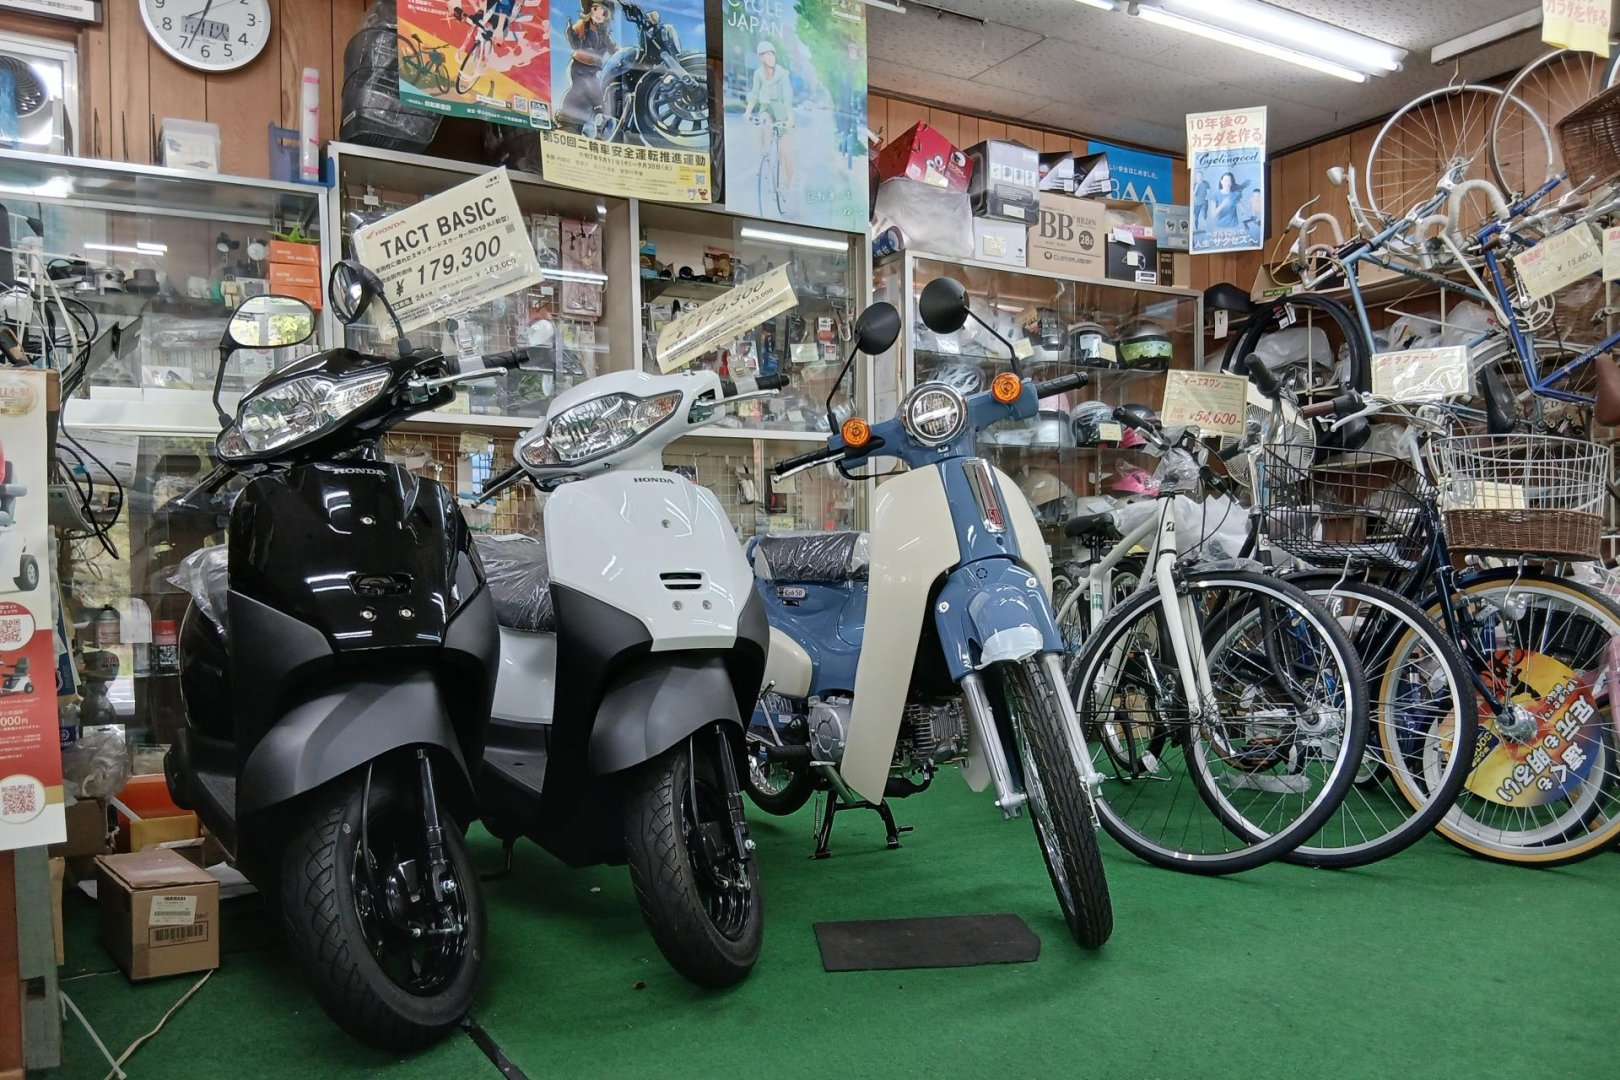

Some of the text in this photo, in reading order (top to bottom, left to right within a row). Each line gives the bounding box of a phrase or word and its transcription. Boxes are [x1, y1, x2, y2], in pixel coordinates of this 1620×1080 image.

[162, 17, 172, 31] 8
[247, 13, 256, 27] 3
[728, 12, 783, 38] JAPAN
[179, 35, 188, 49] 7
[238, 33, 248, 46] 4
[200, 45, 211, 58] 6
[224, 43, 233, 57] 5
[1190, 115, 1247, 130] 10年後の
[1192, 127, 1262, 147] カラダを作る
[543, 131, 706, 166] 第50回二輪車安全運転推進運動
[1199, 152, 1258, 168] Cyclingood
[375, 219, 406, 236] HONDA
[380, 197, 497, 259] TACT BASIC
[1039, 210, 1074, 241] BB
[417, 235, 501, 286] 179,300
[333, 467, 387, 477] HONDA
[633, 477, 675, 485] HONDA
[1496, 694, 1595, 801] 足元も明るい
[1538, 741, 1587, 792] 遠くも
